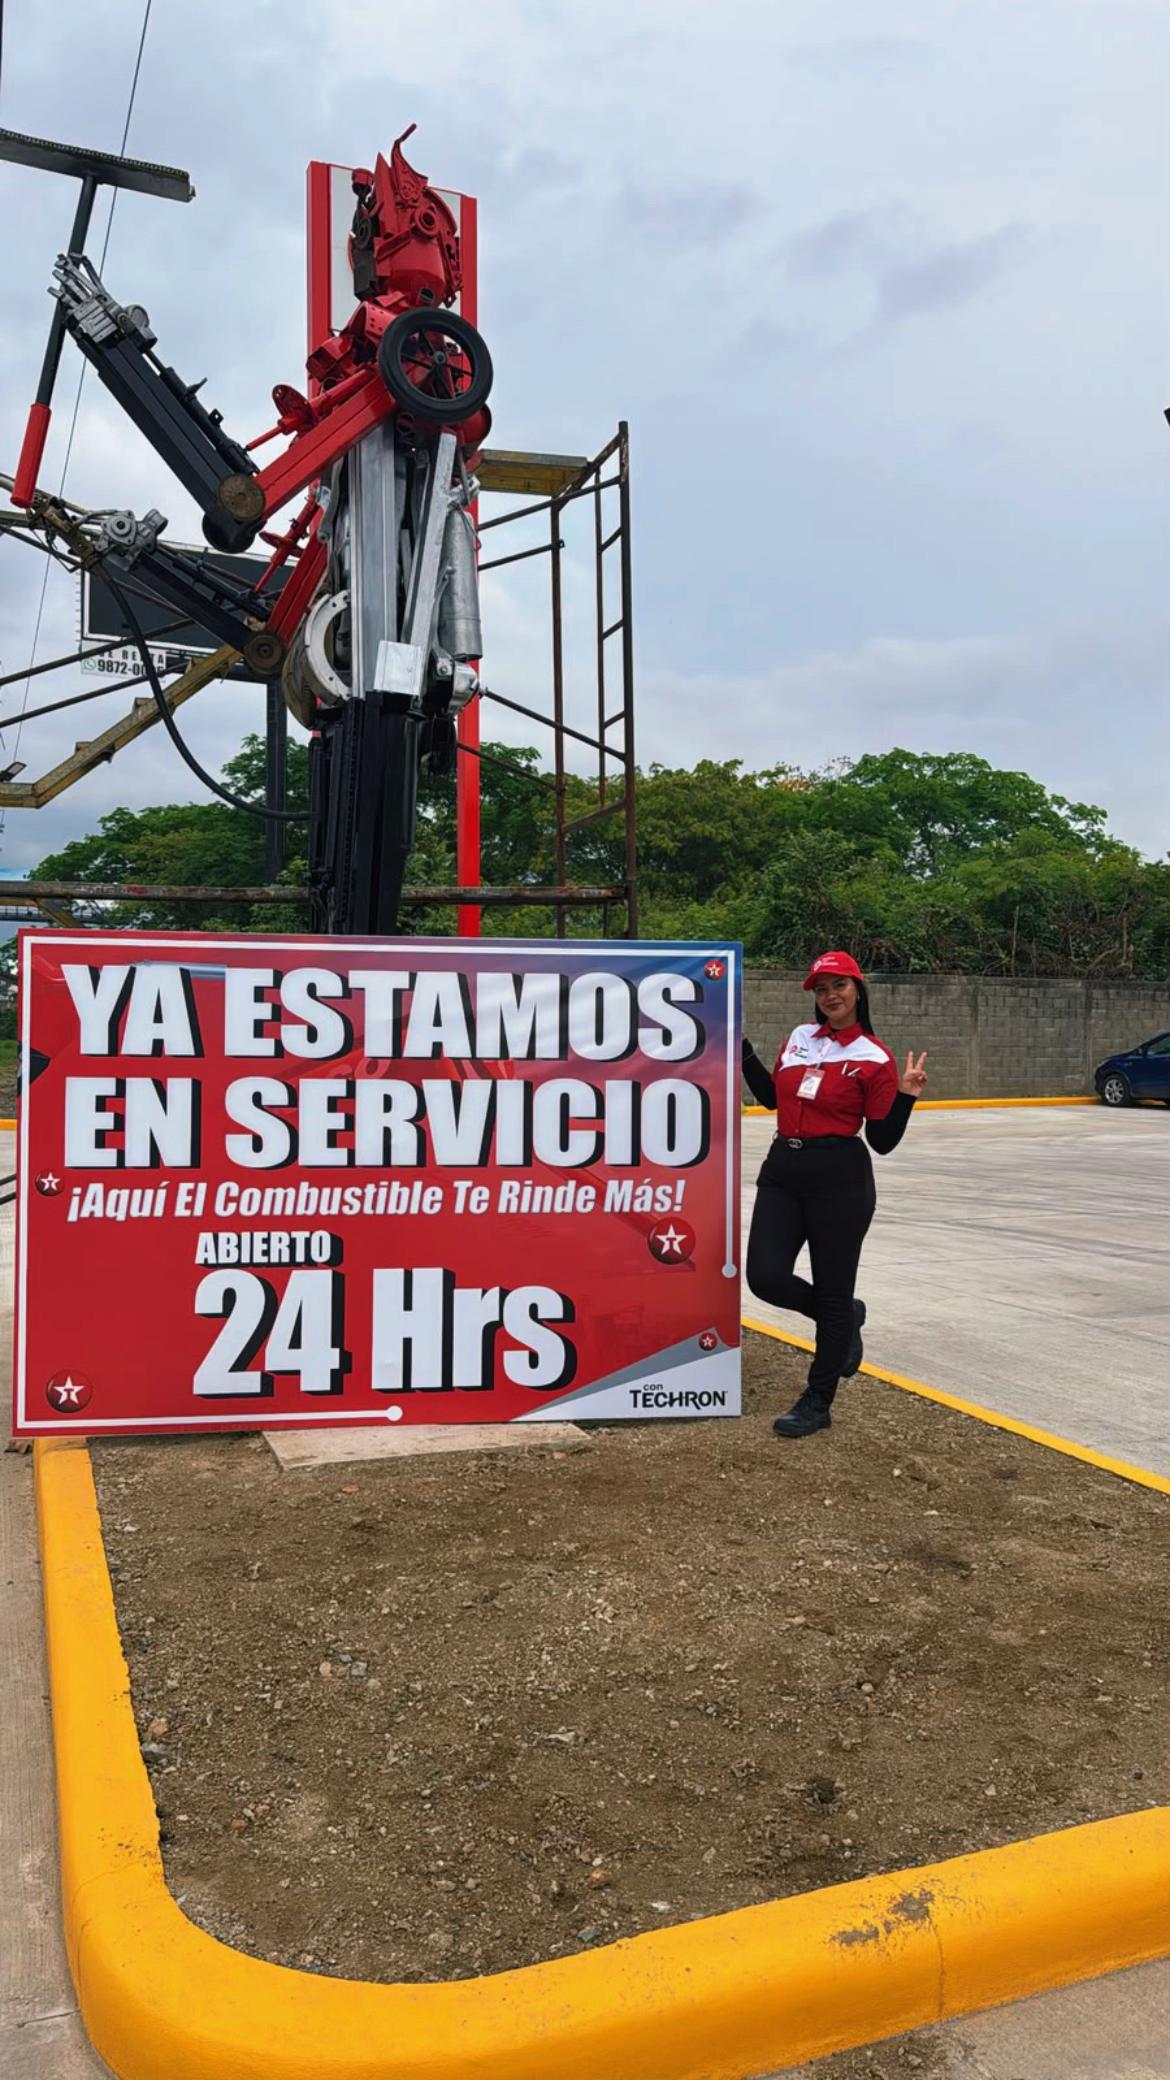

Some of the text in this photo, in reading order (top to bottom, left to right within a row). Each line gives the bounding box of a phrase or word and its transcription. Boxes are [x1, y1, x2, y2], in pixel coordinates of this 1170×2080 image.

[61, 964, 699, 1060] YA ESTAMOS
[65, 1076, 703, 1168] EN SERVICIO
[66, 1178, 686, 1222] ¡Aquí El Combustible Te Rinde Más!
[195, 1230, 332, 1265] ABIERTO
[193, 1267, 566, 1395] 24 Hrs
[629, 1383, 727, 1410] con TECHRON
